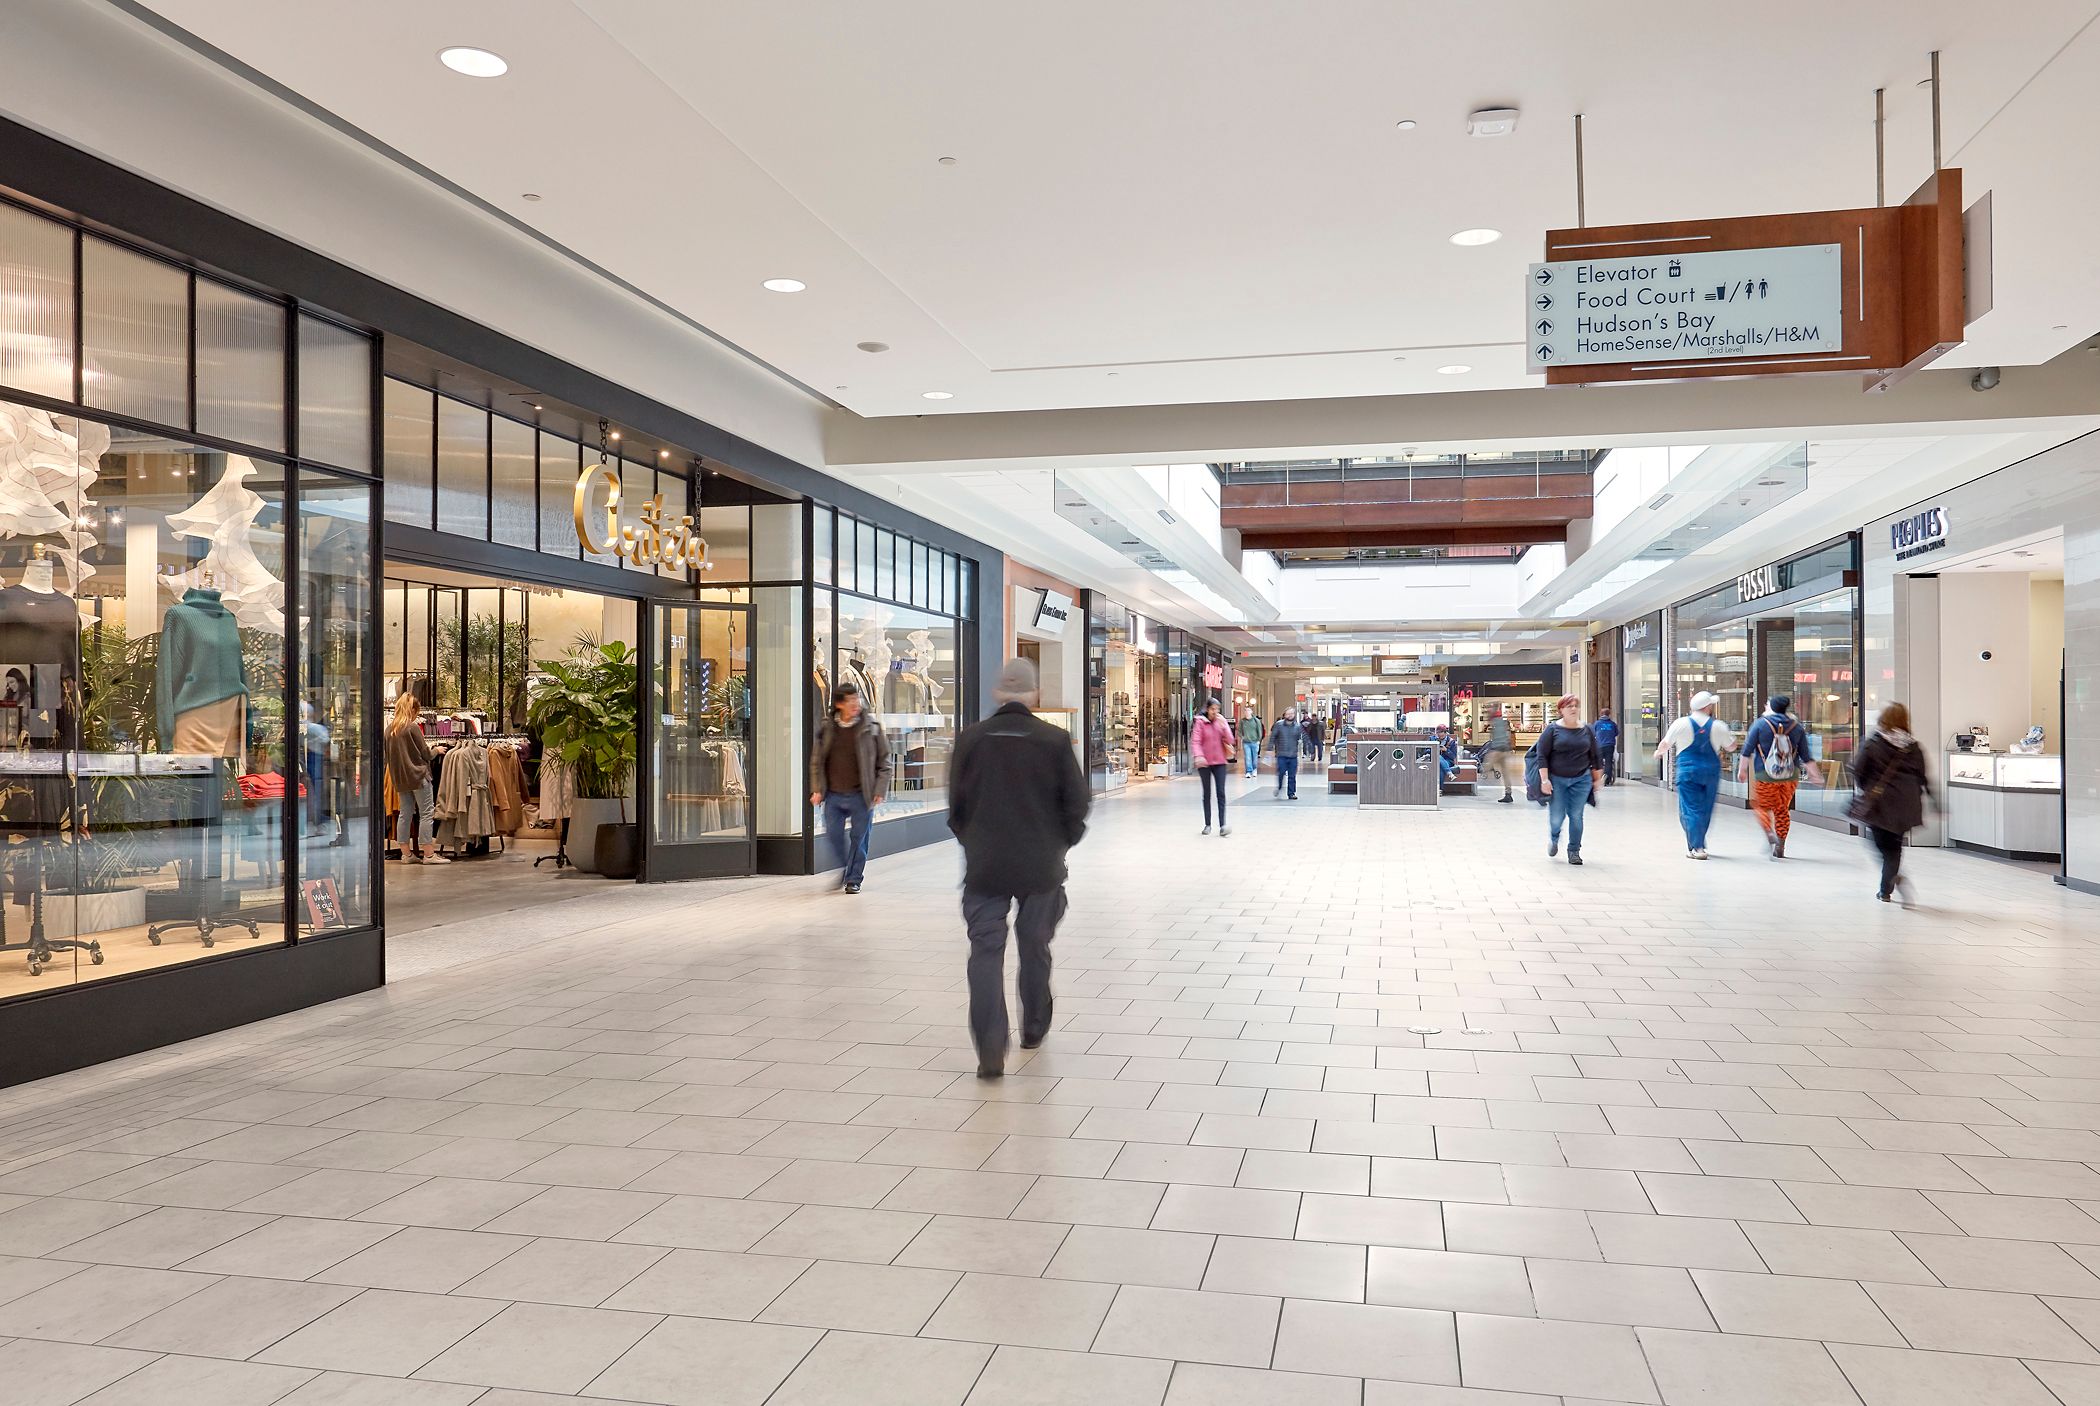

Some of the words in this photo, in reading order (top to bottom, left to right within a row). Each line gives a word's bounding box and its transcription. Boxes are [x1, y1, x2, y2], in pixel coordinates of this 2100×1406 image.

[1577, 265, 1657, 284] Elevator
[1577, 288, 1627, 309] Food
[1637, 287, 1695, 306] Court
[1577, 313, 1668, 334] Hudson's
[1677, 311, 1716, 333] Bay
[1577, 326, 1820, 353] HomeSense/Marshalls/H&M
[573, 463, 714, 572] Aritzia
[1890, 506, 1949, 550] PEOPLES
[1737, 565, 1776, 603] FOSSIL
[312, 893, 332, 901] Work
[316, 902, 321, 910] it
[322, 901, 334, 909] out
